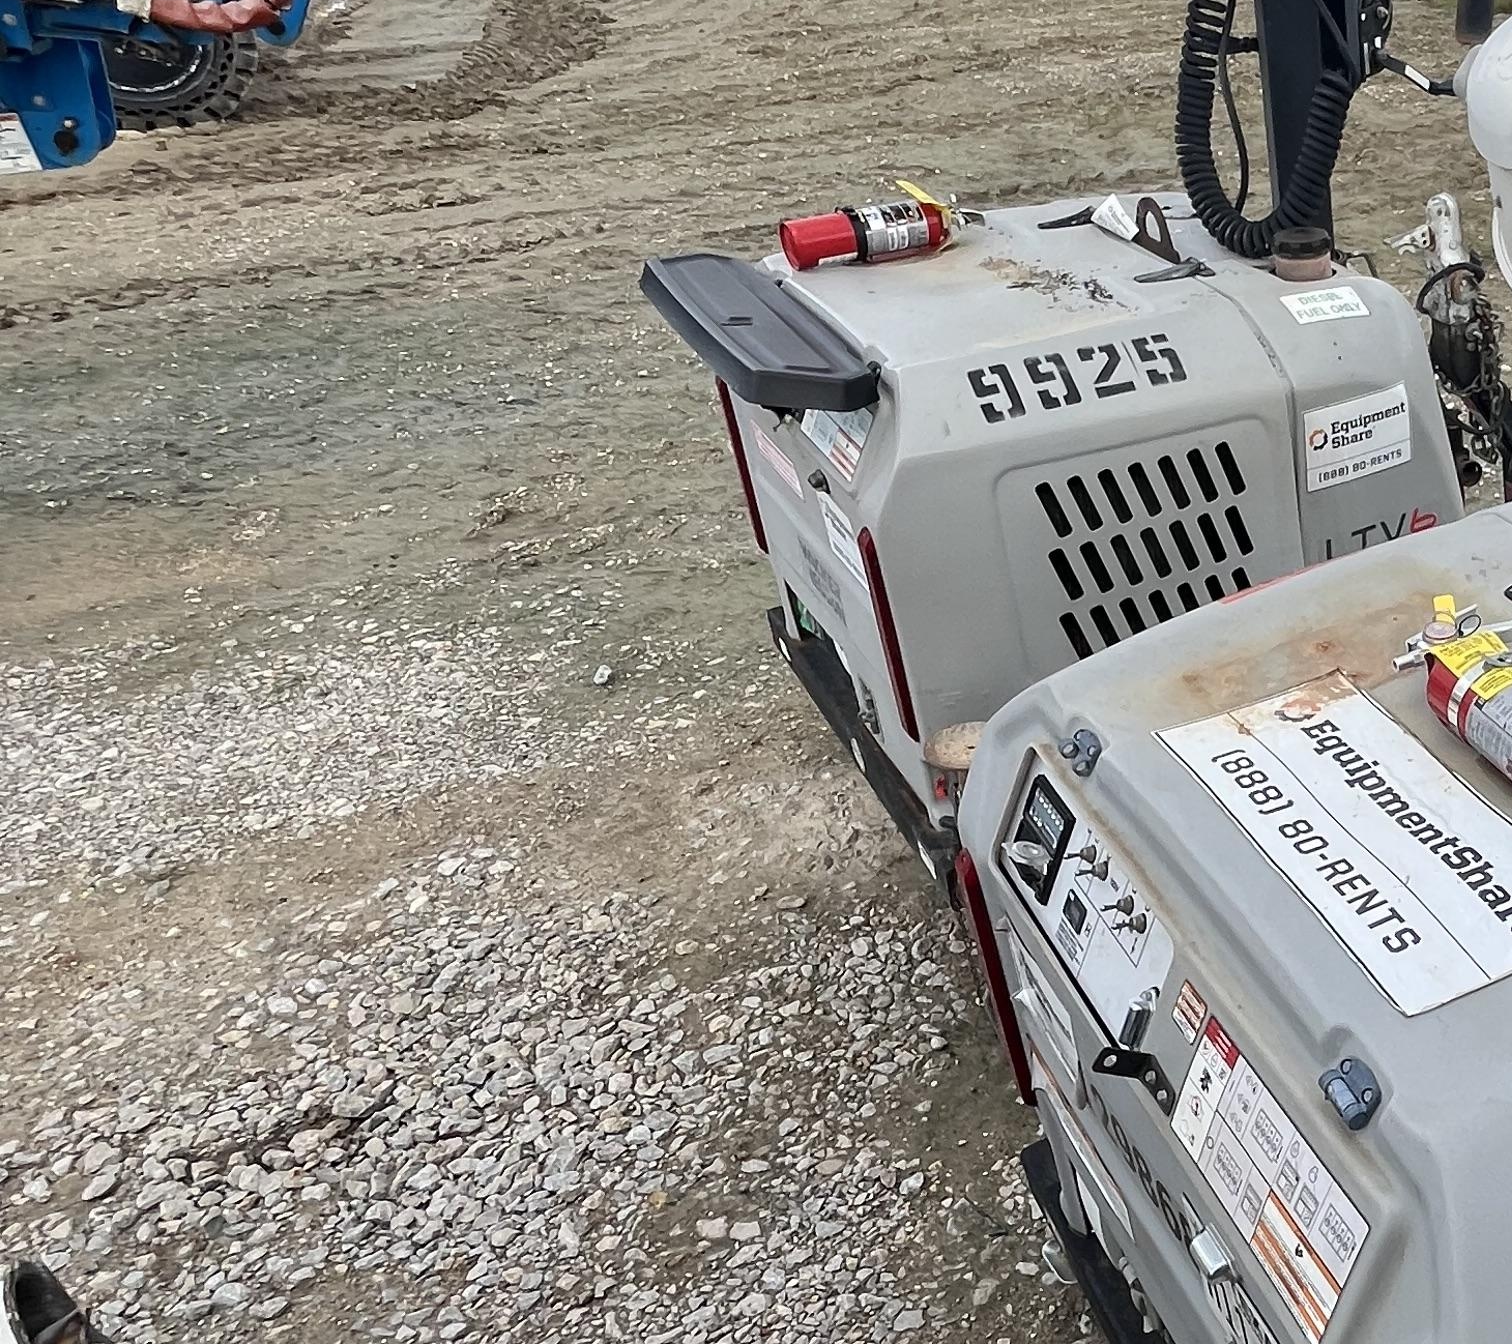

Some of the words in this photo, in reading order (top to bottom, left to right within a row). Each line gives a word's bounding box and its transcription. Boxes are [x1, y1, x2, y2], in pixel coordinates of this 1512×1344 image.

[1296, 306, 1330, 319] FUEL
[1330, 302, 1361, 313] ONLY
[1298, 292, 1343, 306] DIESEL
[967, 333, 1188, 424] 9925
[1331, 402, 1406, 434] Equipment
[1332, 429, 1373, 449] Share
[1318, 466, 1349, 483] (888)
[1352, 449, 1402, 476] 80-RENTS
[1211, 748, 1294, 816] (888)
[1278, 819, 1422, 954] 80-RENTS
